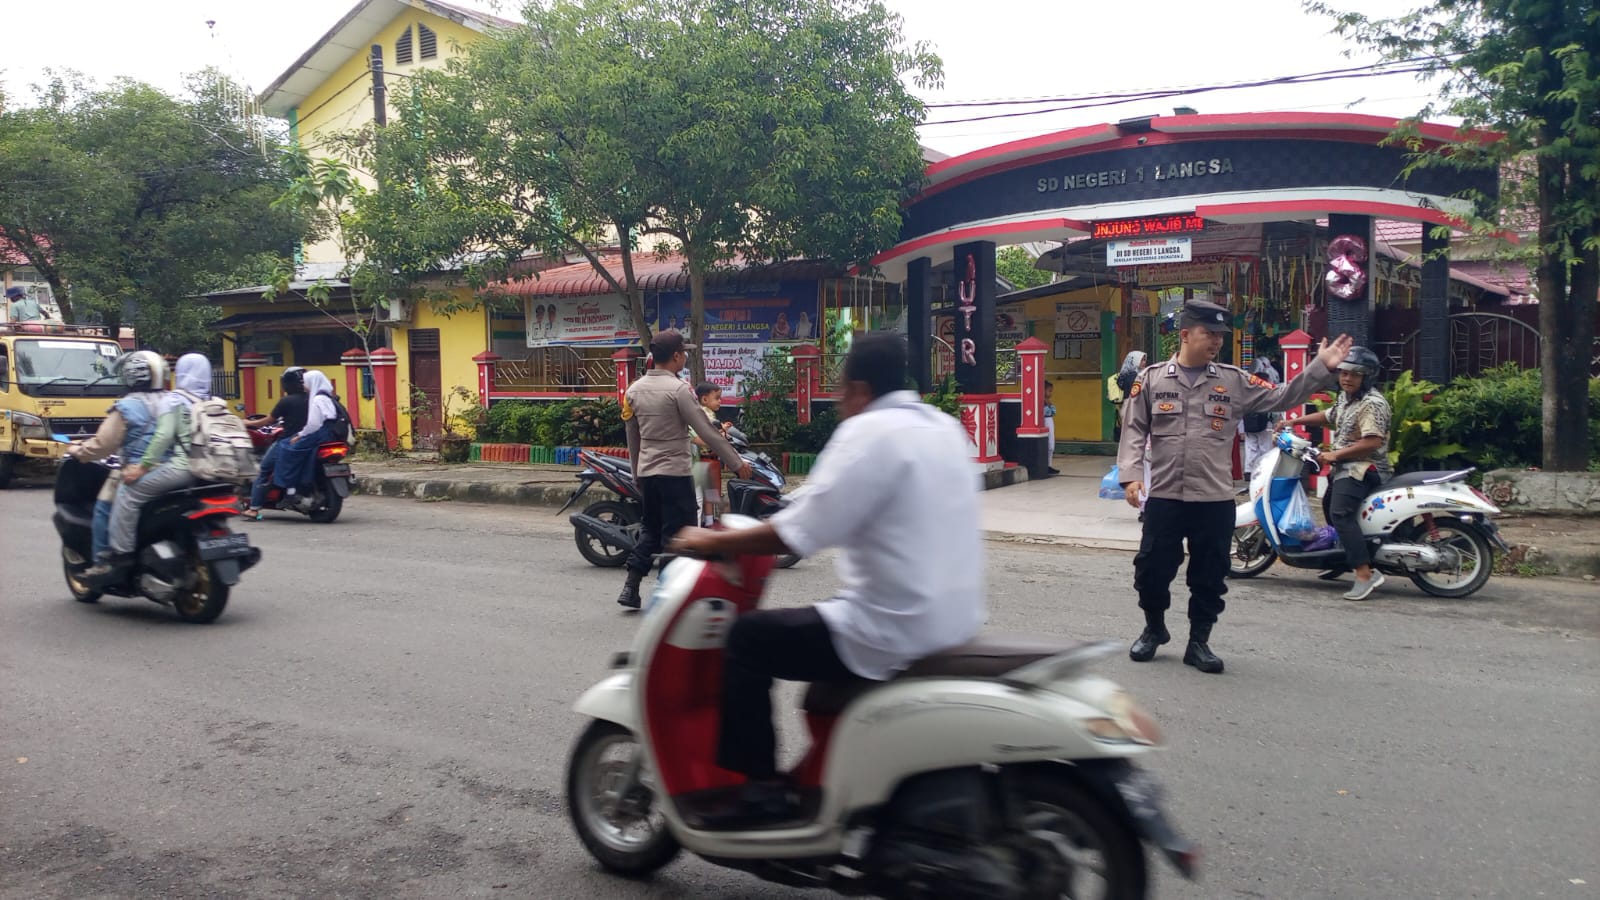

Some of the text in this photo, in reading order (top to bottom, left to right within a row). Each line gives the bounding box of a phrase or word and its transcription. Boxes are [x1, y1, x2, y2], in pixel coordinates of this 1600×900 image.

[1037, 157, 1234, 192] SD NEGERI 1 LANGSA
[1144, 217, 1182, 232] WAJIB
[742, 322, 770, 331] LANGSA
